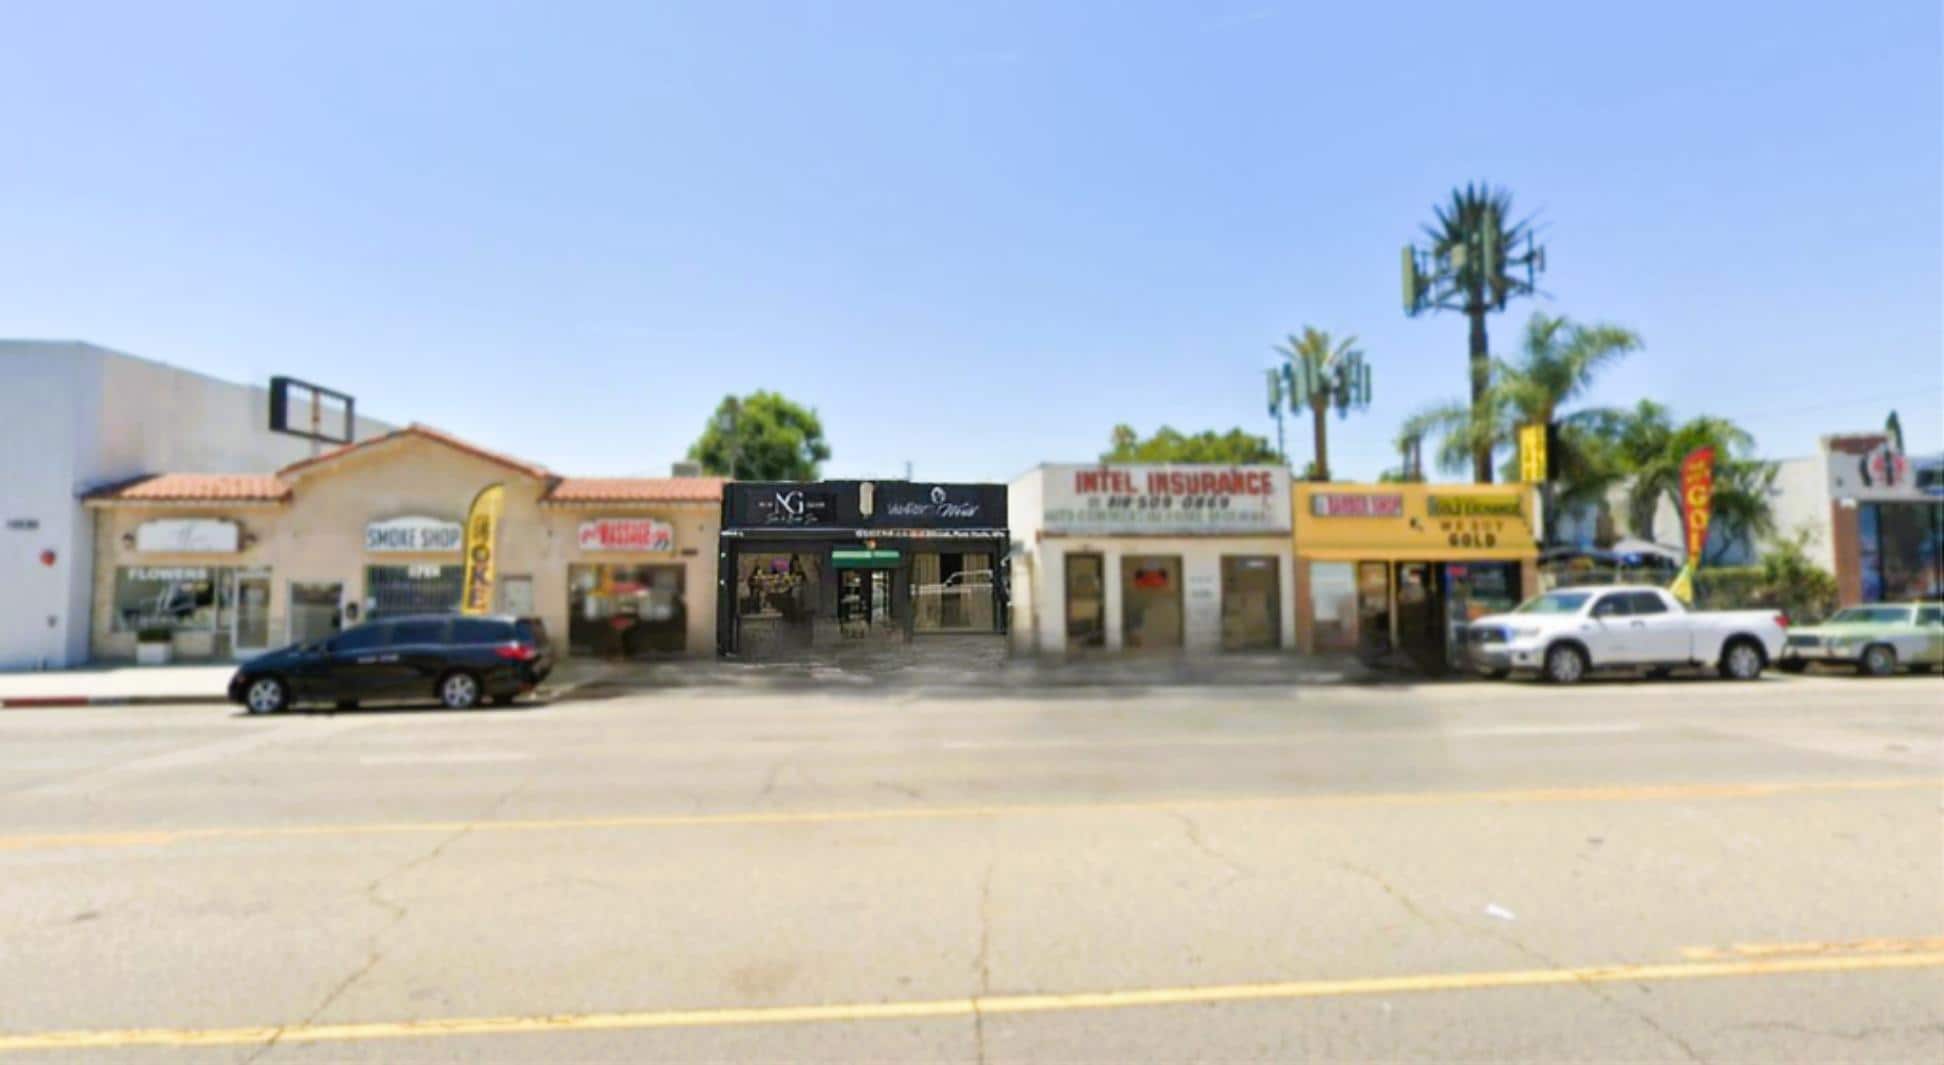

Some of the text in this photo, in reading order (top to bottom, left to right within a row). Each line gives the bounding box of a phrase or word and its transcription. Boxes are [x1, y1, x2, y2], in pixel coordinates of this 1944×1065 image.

[1074, 470, 1272, 496] INTEL INSURANCE
[367, 526, 460, 548] SMOKE SHOP
[1448, 533, 1496, 548] GOLD
